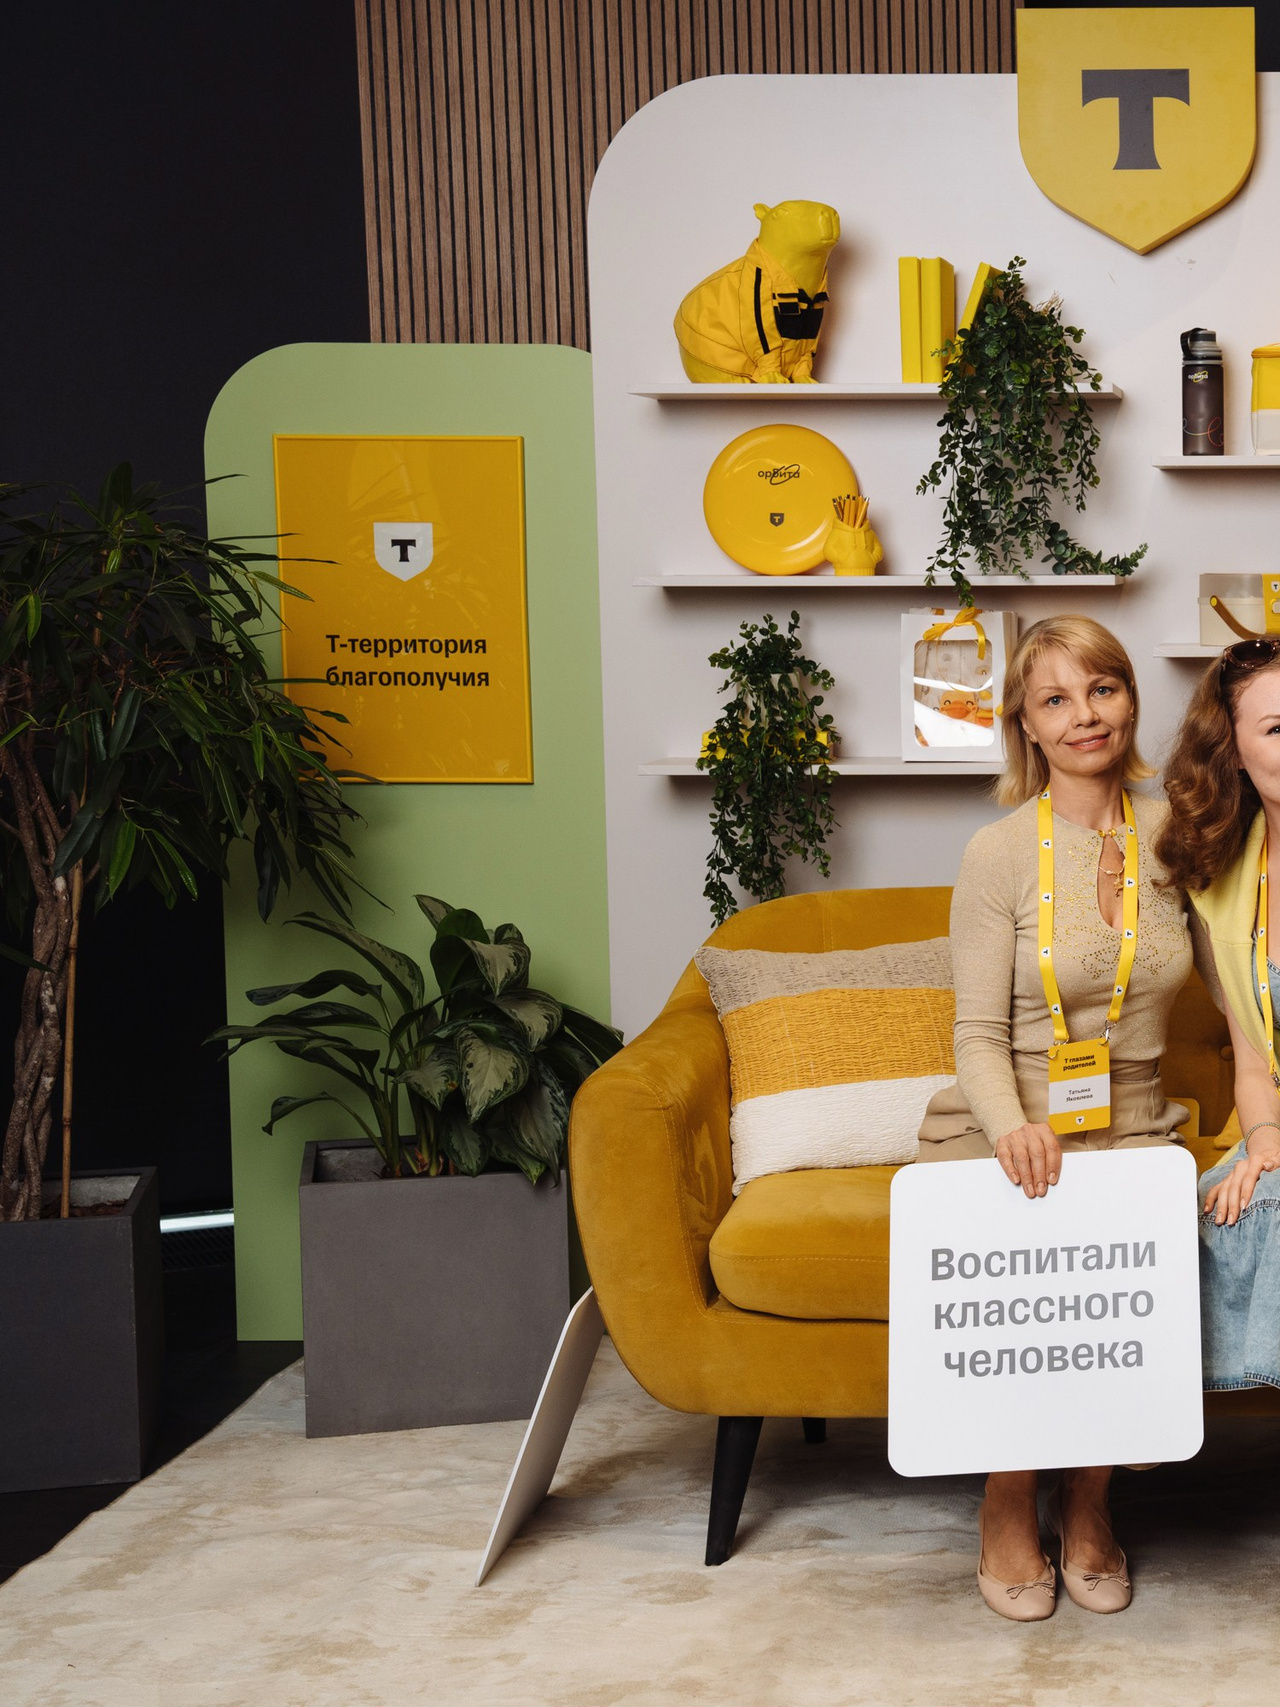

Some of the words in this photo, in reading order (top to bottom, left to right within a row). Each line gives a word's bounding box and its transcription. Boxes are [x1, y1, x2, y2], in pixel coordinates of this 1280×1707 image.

[1081, 69, 1190, 170] Т
[757, 467, 801, 481] орбита
[391, 538, 416, 563] Т
[325, 634, 488, 658] Т-территория
[325, 665, 491, 691] благополучия
[1063, 1060, 1097, 1072] родителей
[1069, 1054, 1095, 1063] глазами
[1068, 1087, 1091, 1095] Татьяна
[930, 1240, 1157, 1282] Воспитали
[934, 1289, 1155, 1330] классного
[944, 1339, 1144, 1378] человека
